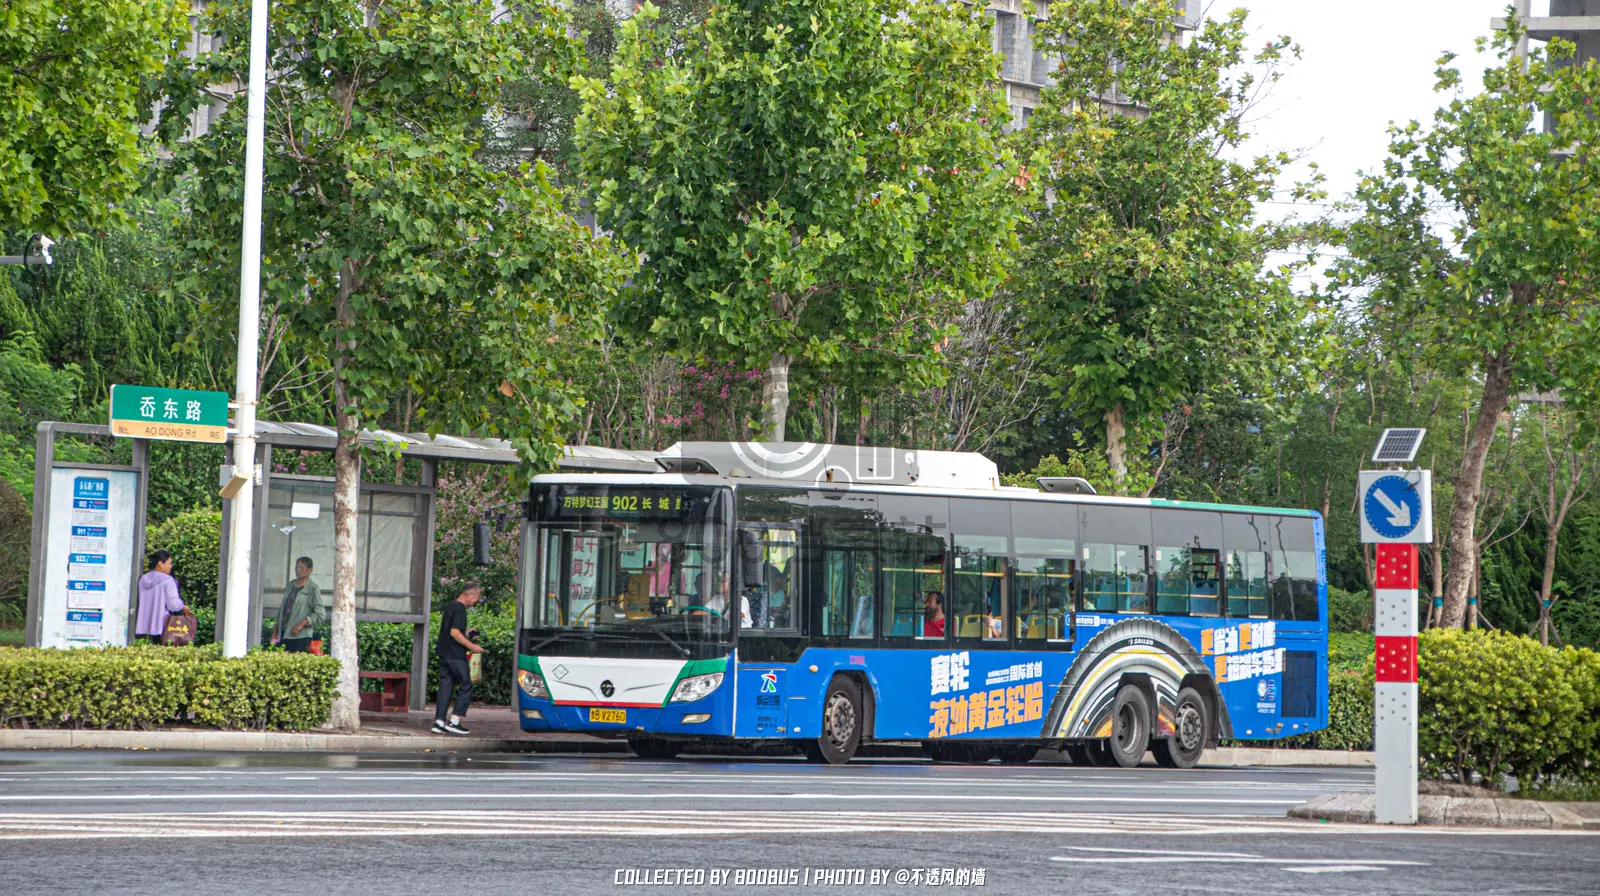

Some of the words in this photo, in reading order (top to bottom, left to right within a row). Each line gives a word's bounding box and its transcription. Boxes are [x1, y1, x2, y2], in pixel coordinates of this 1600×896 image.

[139, 396, 202, 421] 岙东路
[145, 426, 157, 436] AO
[158, 427, 183, 437] DONG
[185, 429, 196, 439] Rd
[563, 496, 609, 509] 方特梦幻王国
[612, 495, 638, 511] 902
[931, 651, 969, 696] 赛轮
[1010, 661, 1042, 682] 国际首创
[928, 681, 1043, 738] 液体黄金轮胎
